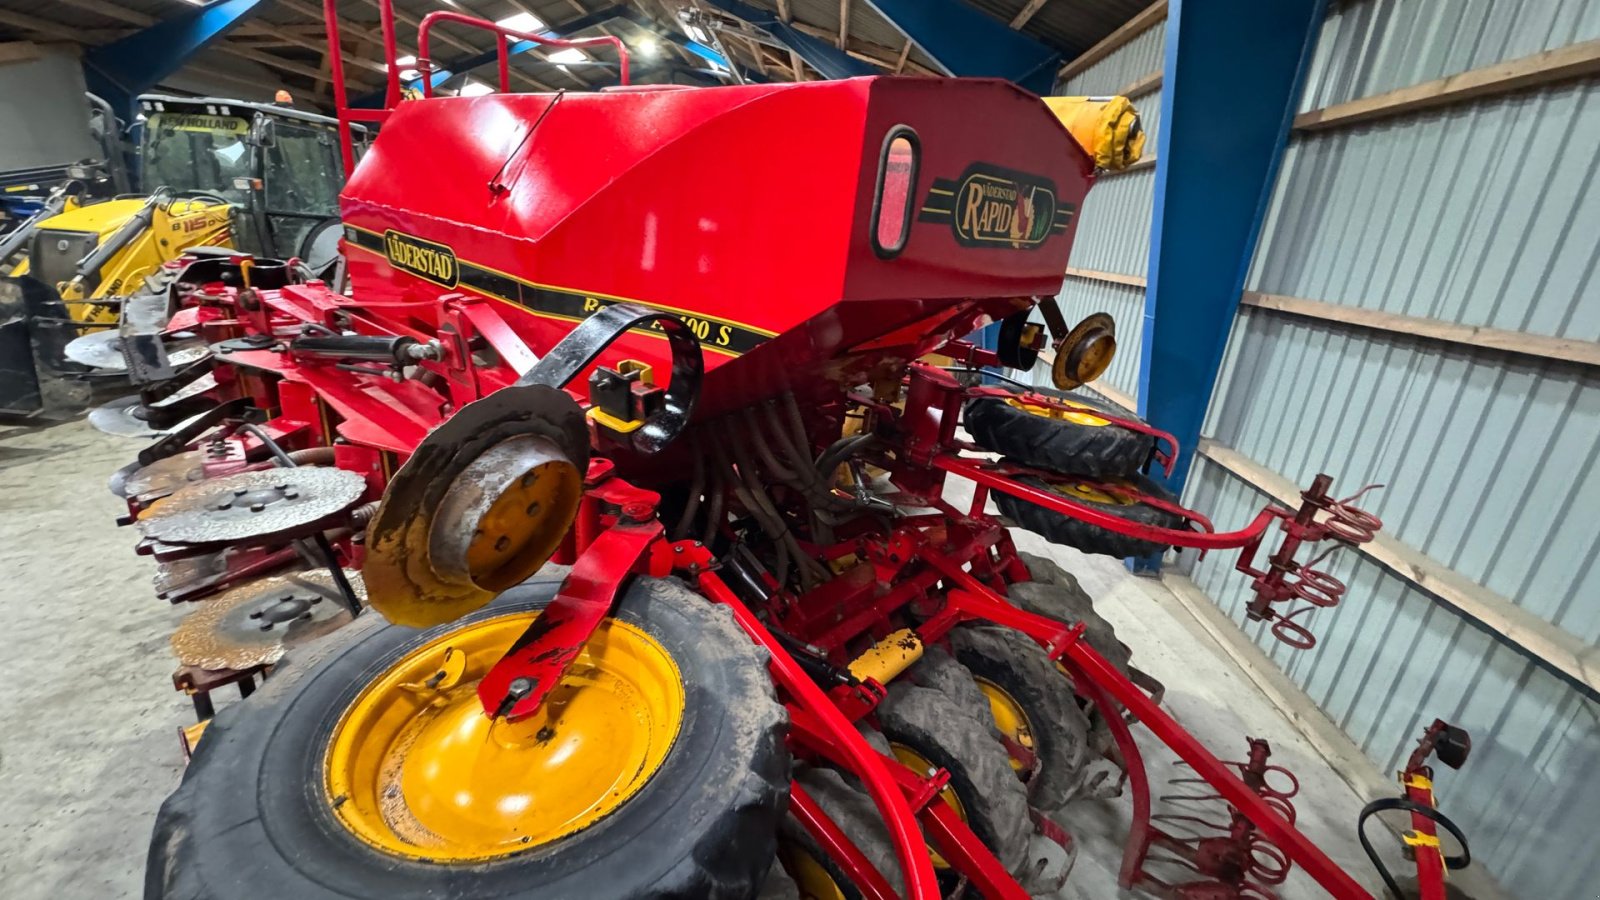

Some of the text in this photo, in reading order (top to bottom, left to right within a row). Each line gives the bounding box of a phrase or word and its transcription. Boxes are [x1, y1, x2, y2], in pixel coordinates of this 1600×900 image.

[187, 118, 238, 131] HOLLAND
[982, 182, 1017, 201] VÄDERSTAD
[962, 182, 1012, 239] RAPID
[387, 234, 452, 280] VÄDERSTAD
[679, 316, 710, 340] 00
[715, 325, 733, 346] S
